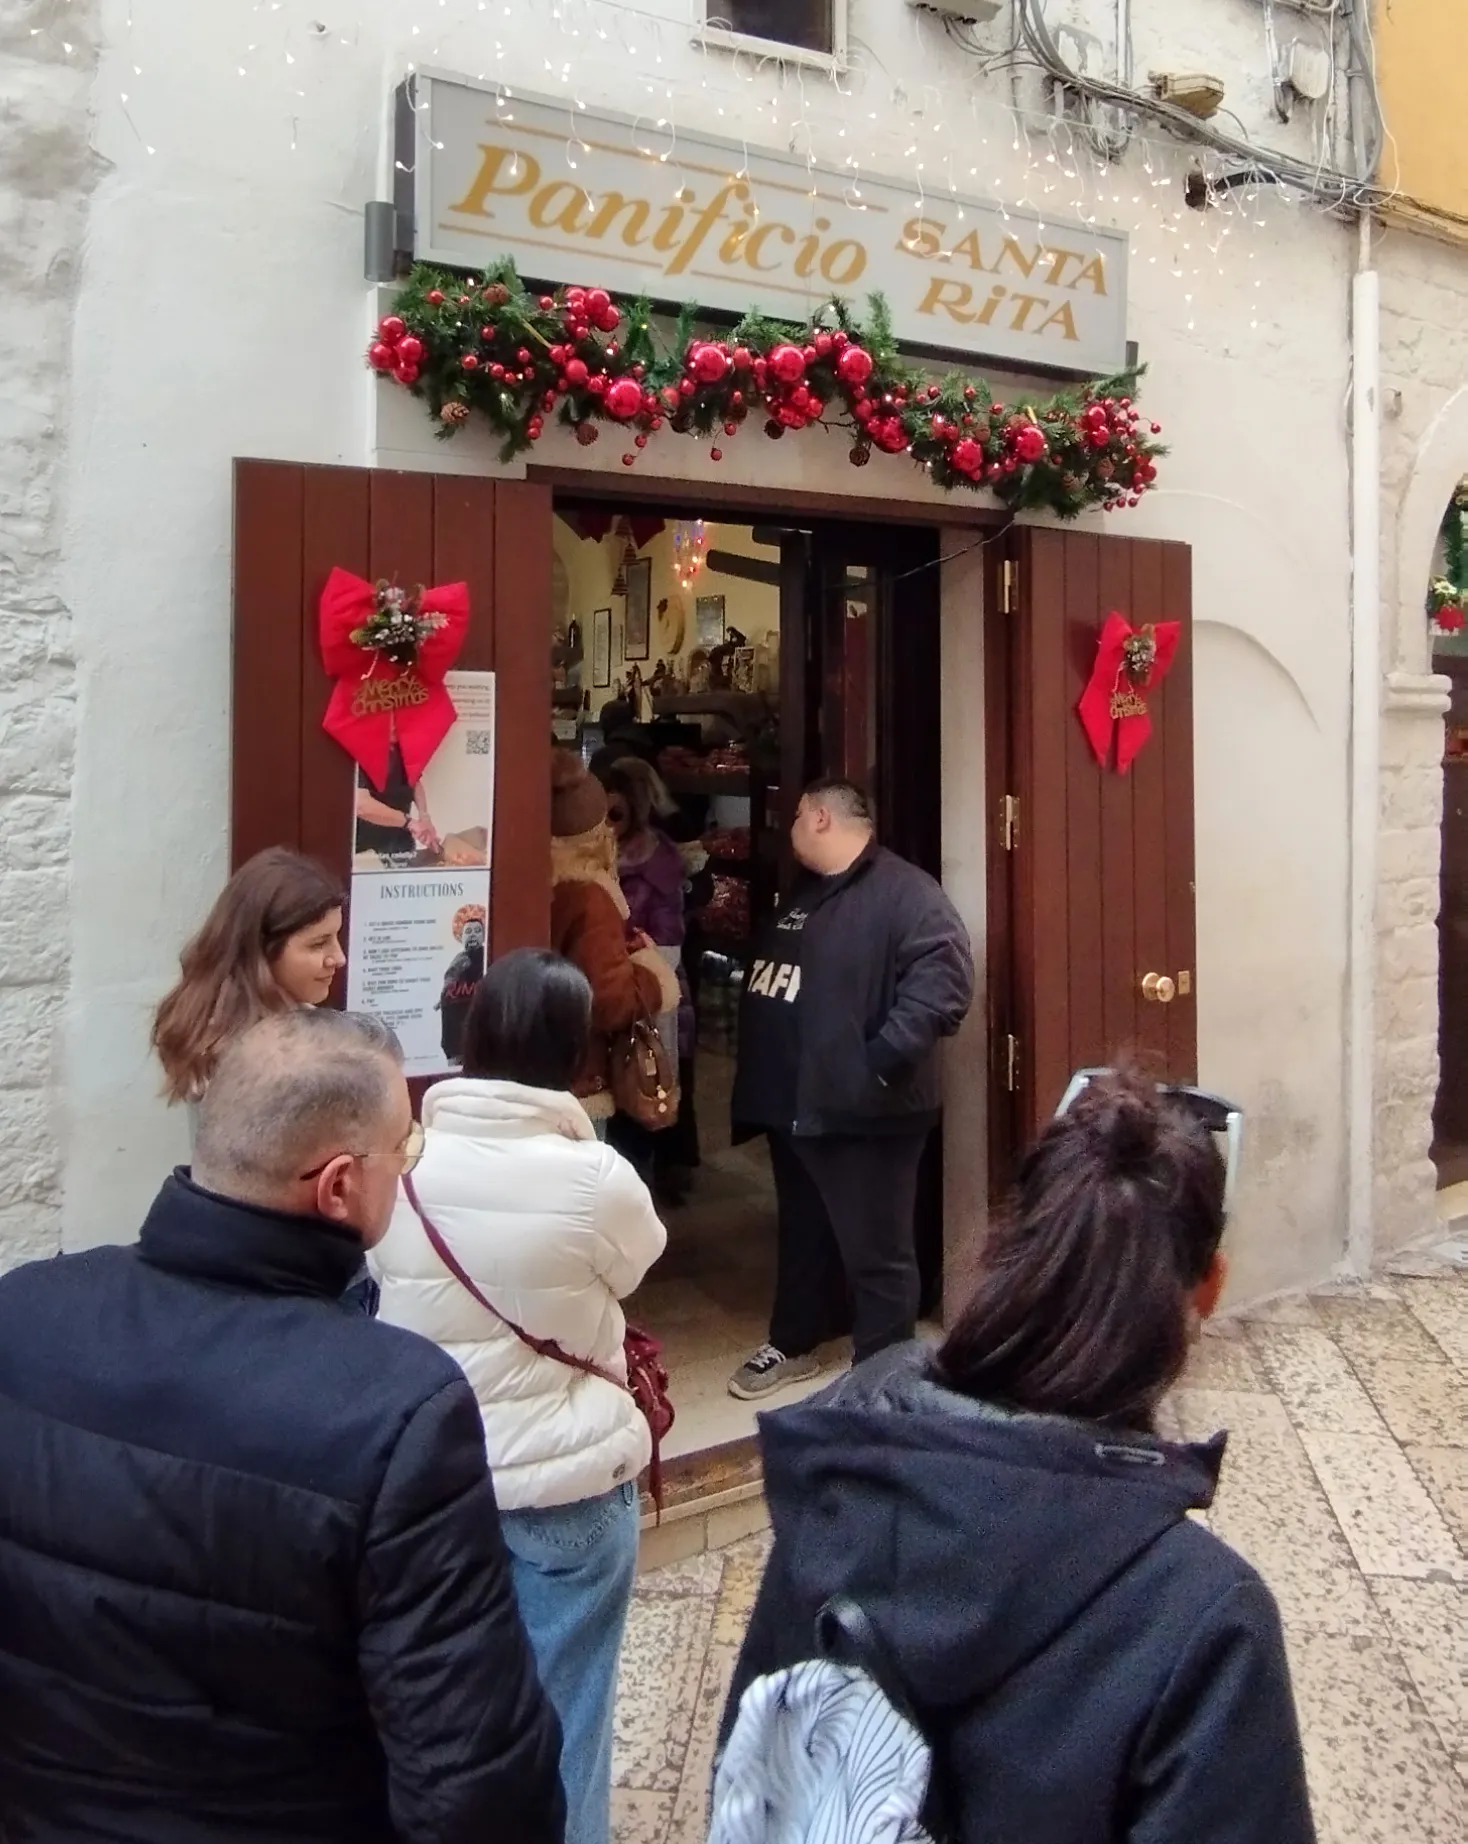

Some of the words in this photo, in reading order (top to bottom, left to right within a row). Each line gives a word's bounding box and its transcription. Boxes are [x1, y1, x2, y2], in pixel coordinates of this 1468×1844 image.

[447, 142, 868, 277] Panificio
[895, 216, 1108, 297] SANTA
[381, 882, 464, 900] INSTRUCTIONS
